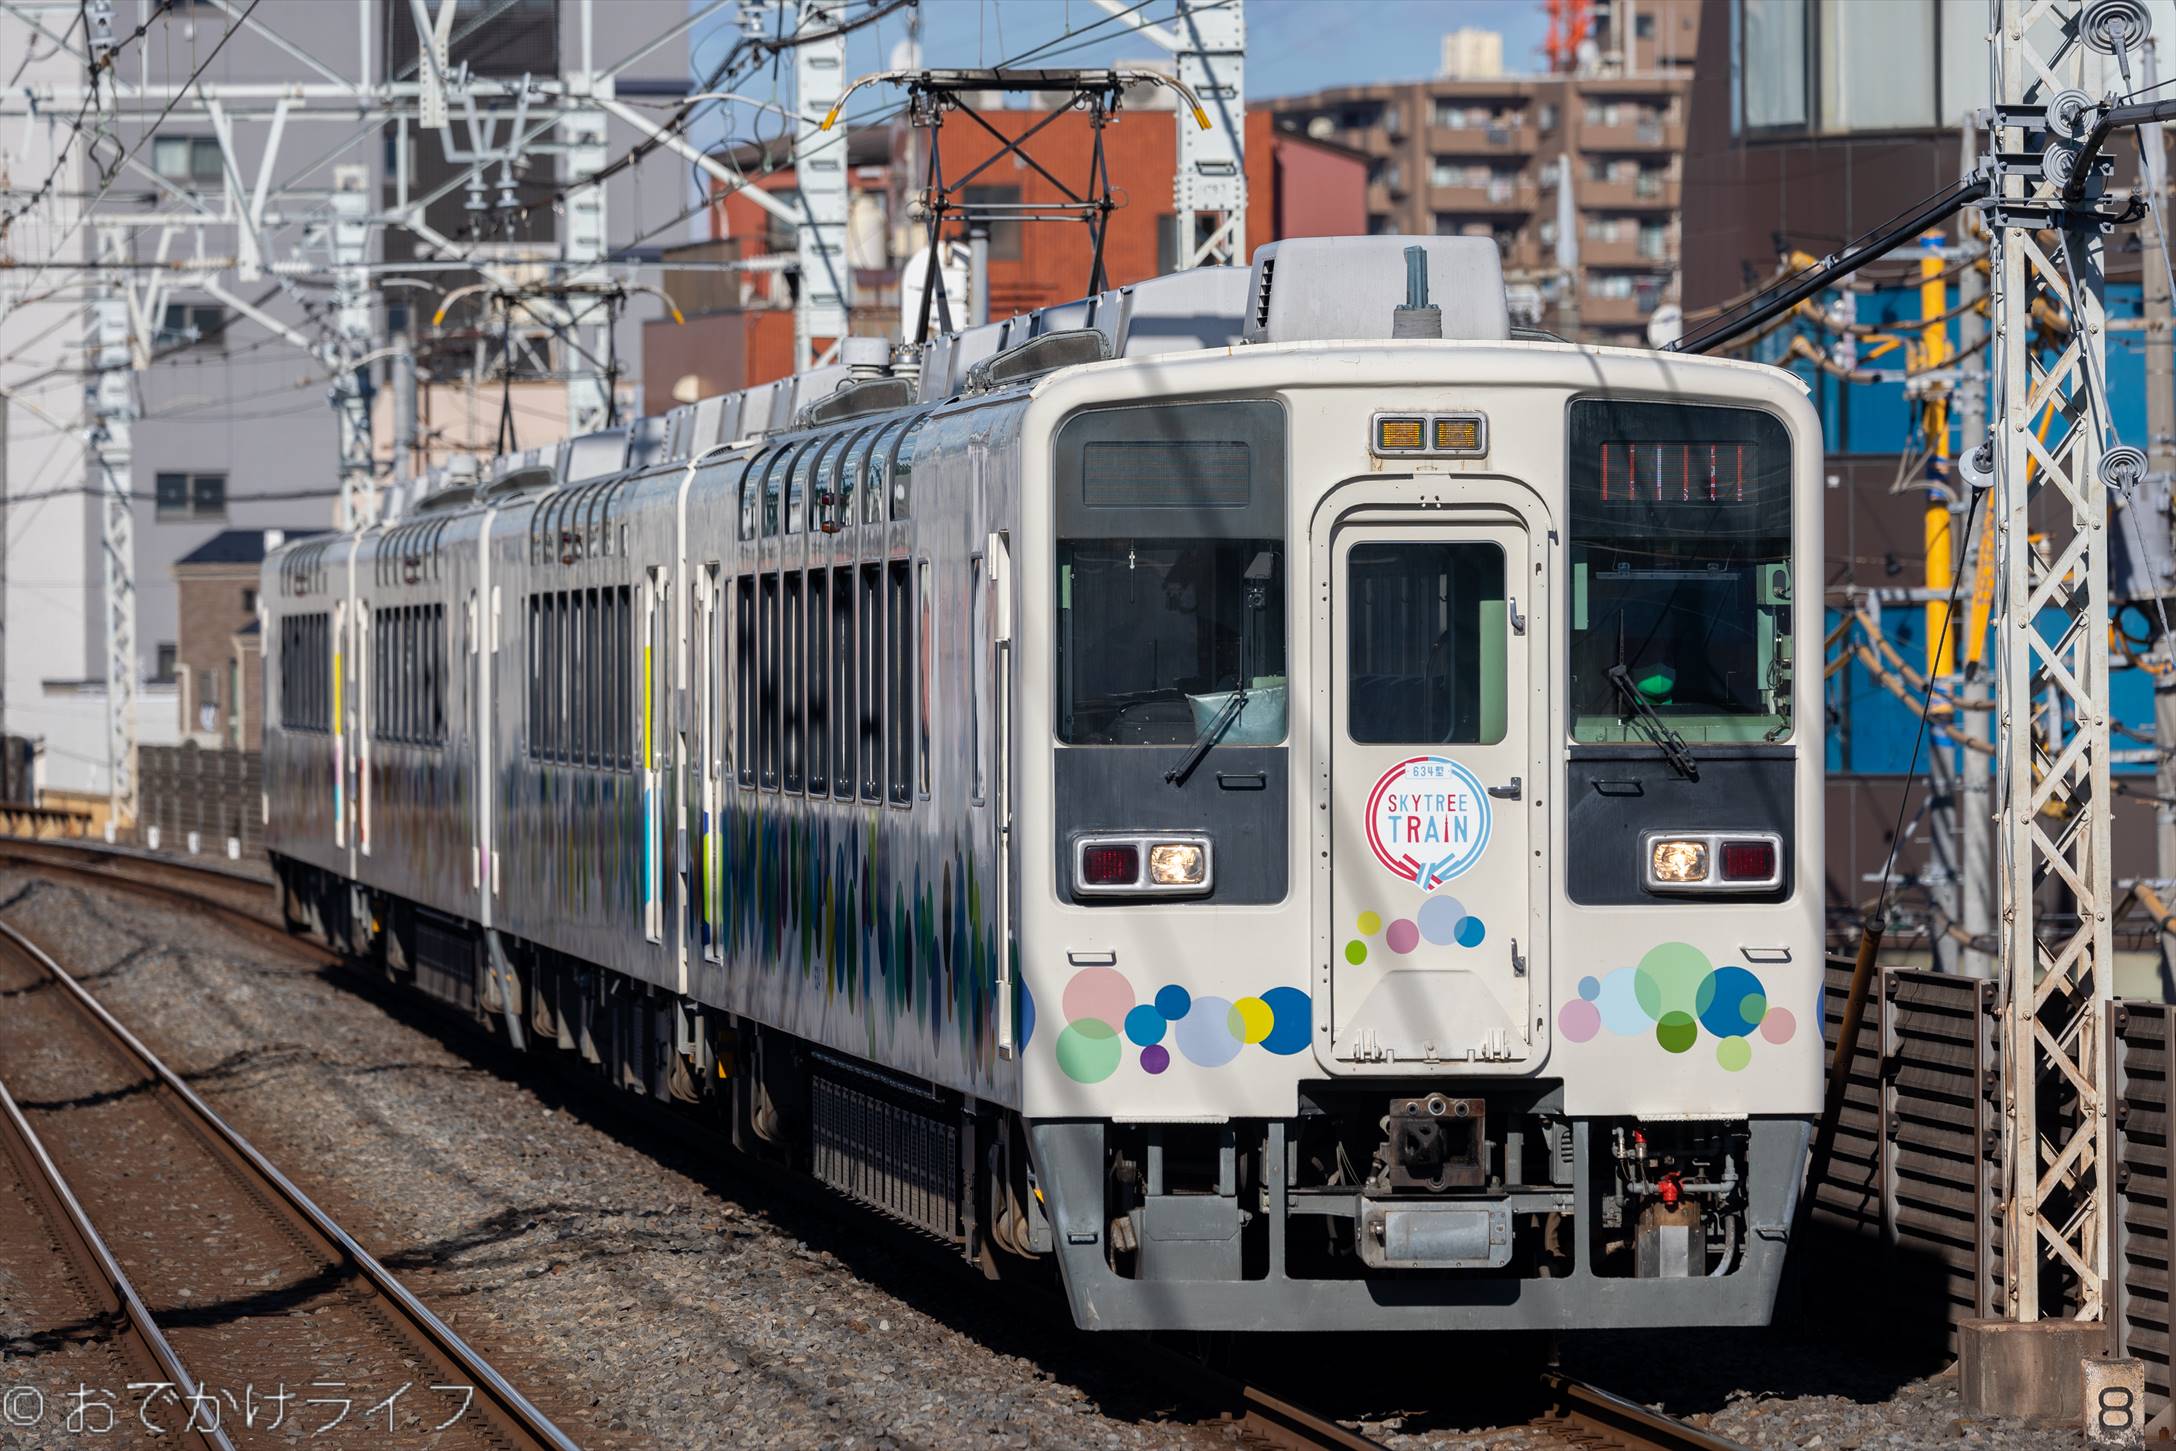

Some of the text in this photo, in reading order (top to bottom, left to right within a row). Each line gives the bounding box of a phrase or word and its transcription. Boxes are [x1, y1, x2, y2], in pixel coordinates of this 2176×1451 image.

[1388, 794, 1467, 812] SKYTREE
[1388, 814, 1467, 843] TRAIN
[2099, 1387, 2133, 1432] 8
